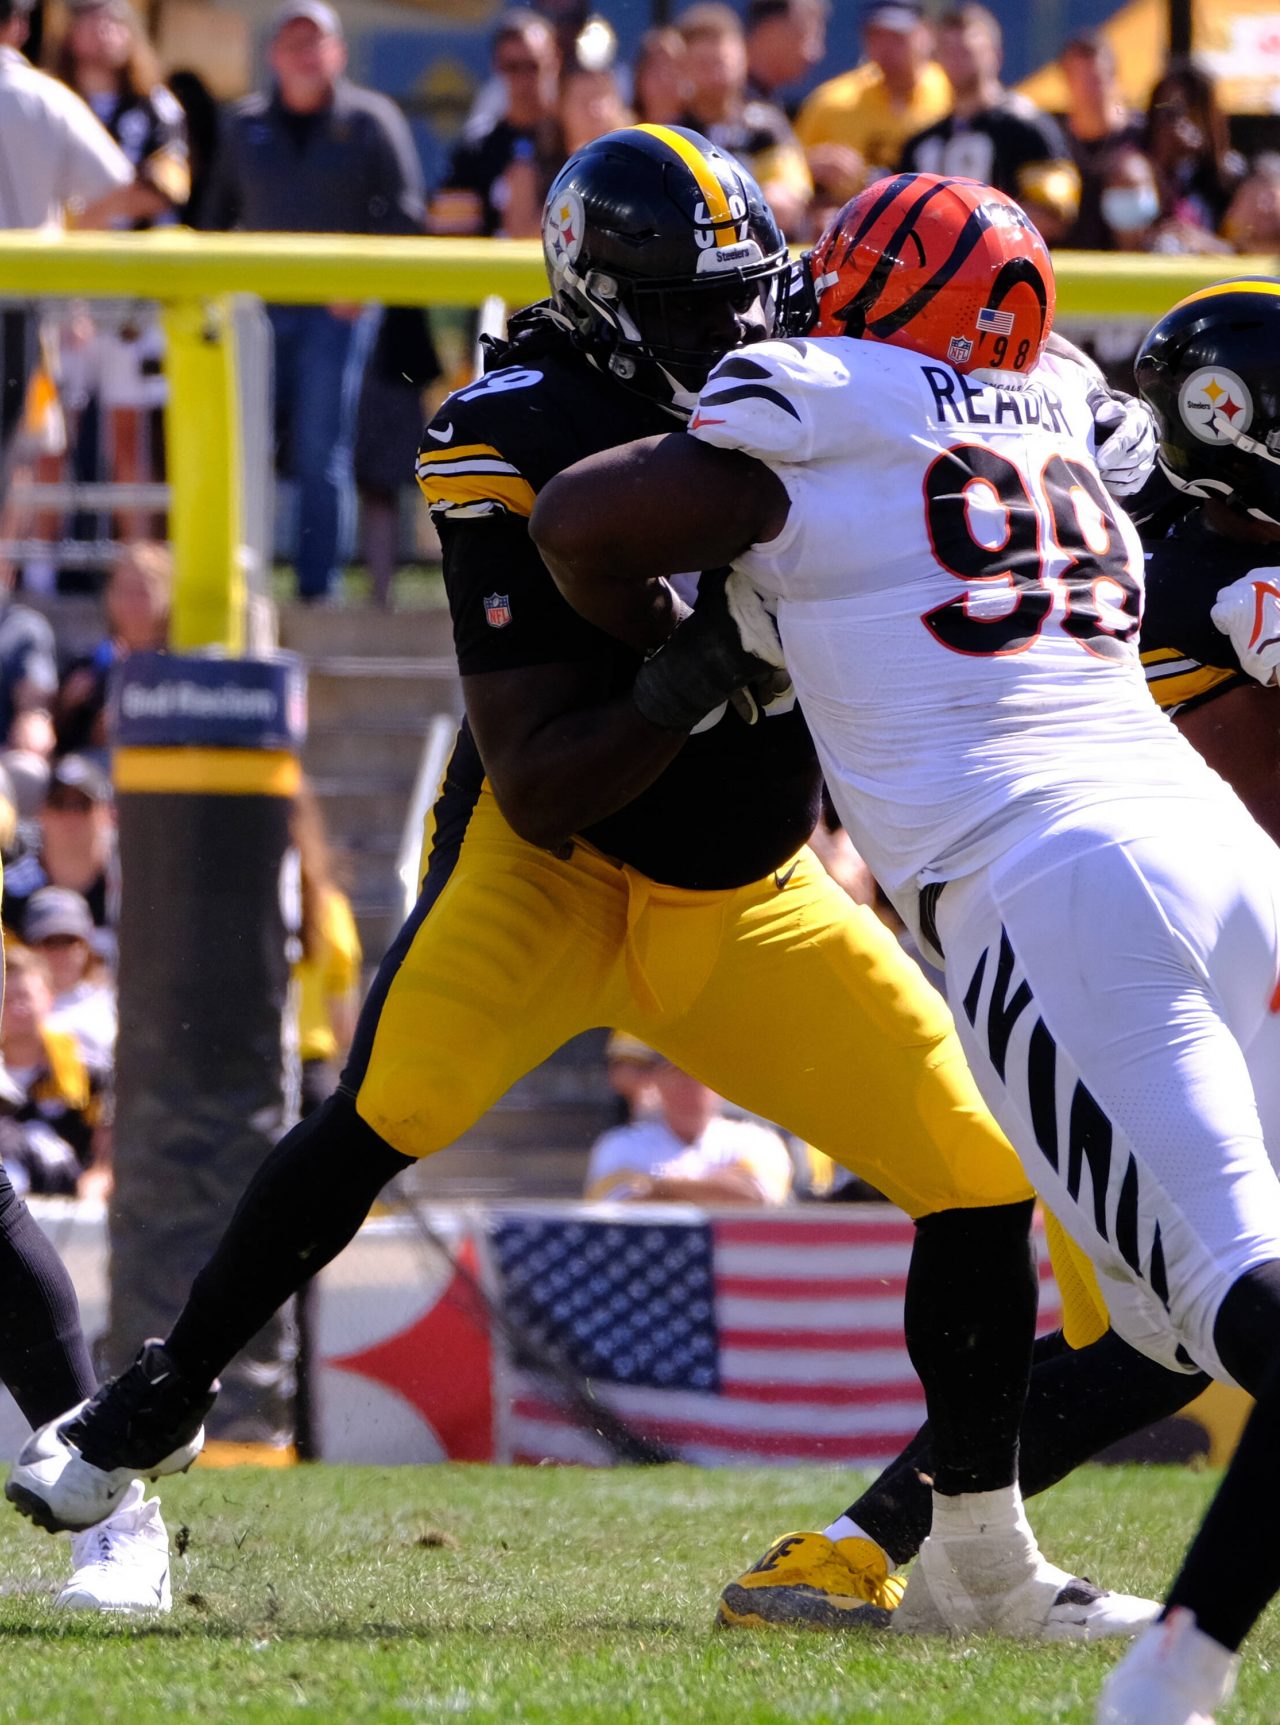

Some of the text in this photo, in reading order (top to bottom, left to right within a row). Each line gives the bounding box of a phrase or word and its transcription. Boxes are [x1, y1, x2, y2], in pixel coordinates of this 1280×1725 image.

[716, 248, 750, 263] Steelers
[921, 366, 1074, 437] READR
[1186, 401, 1211, 410] Steelers
[921, 442, 1141, 667] 98
